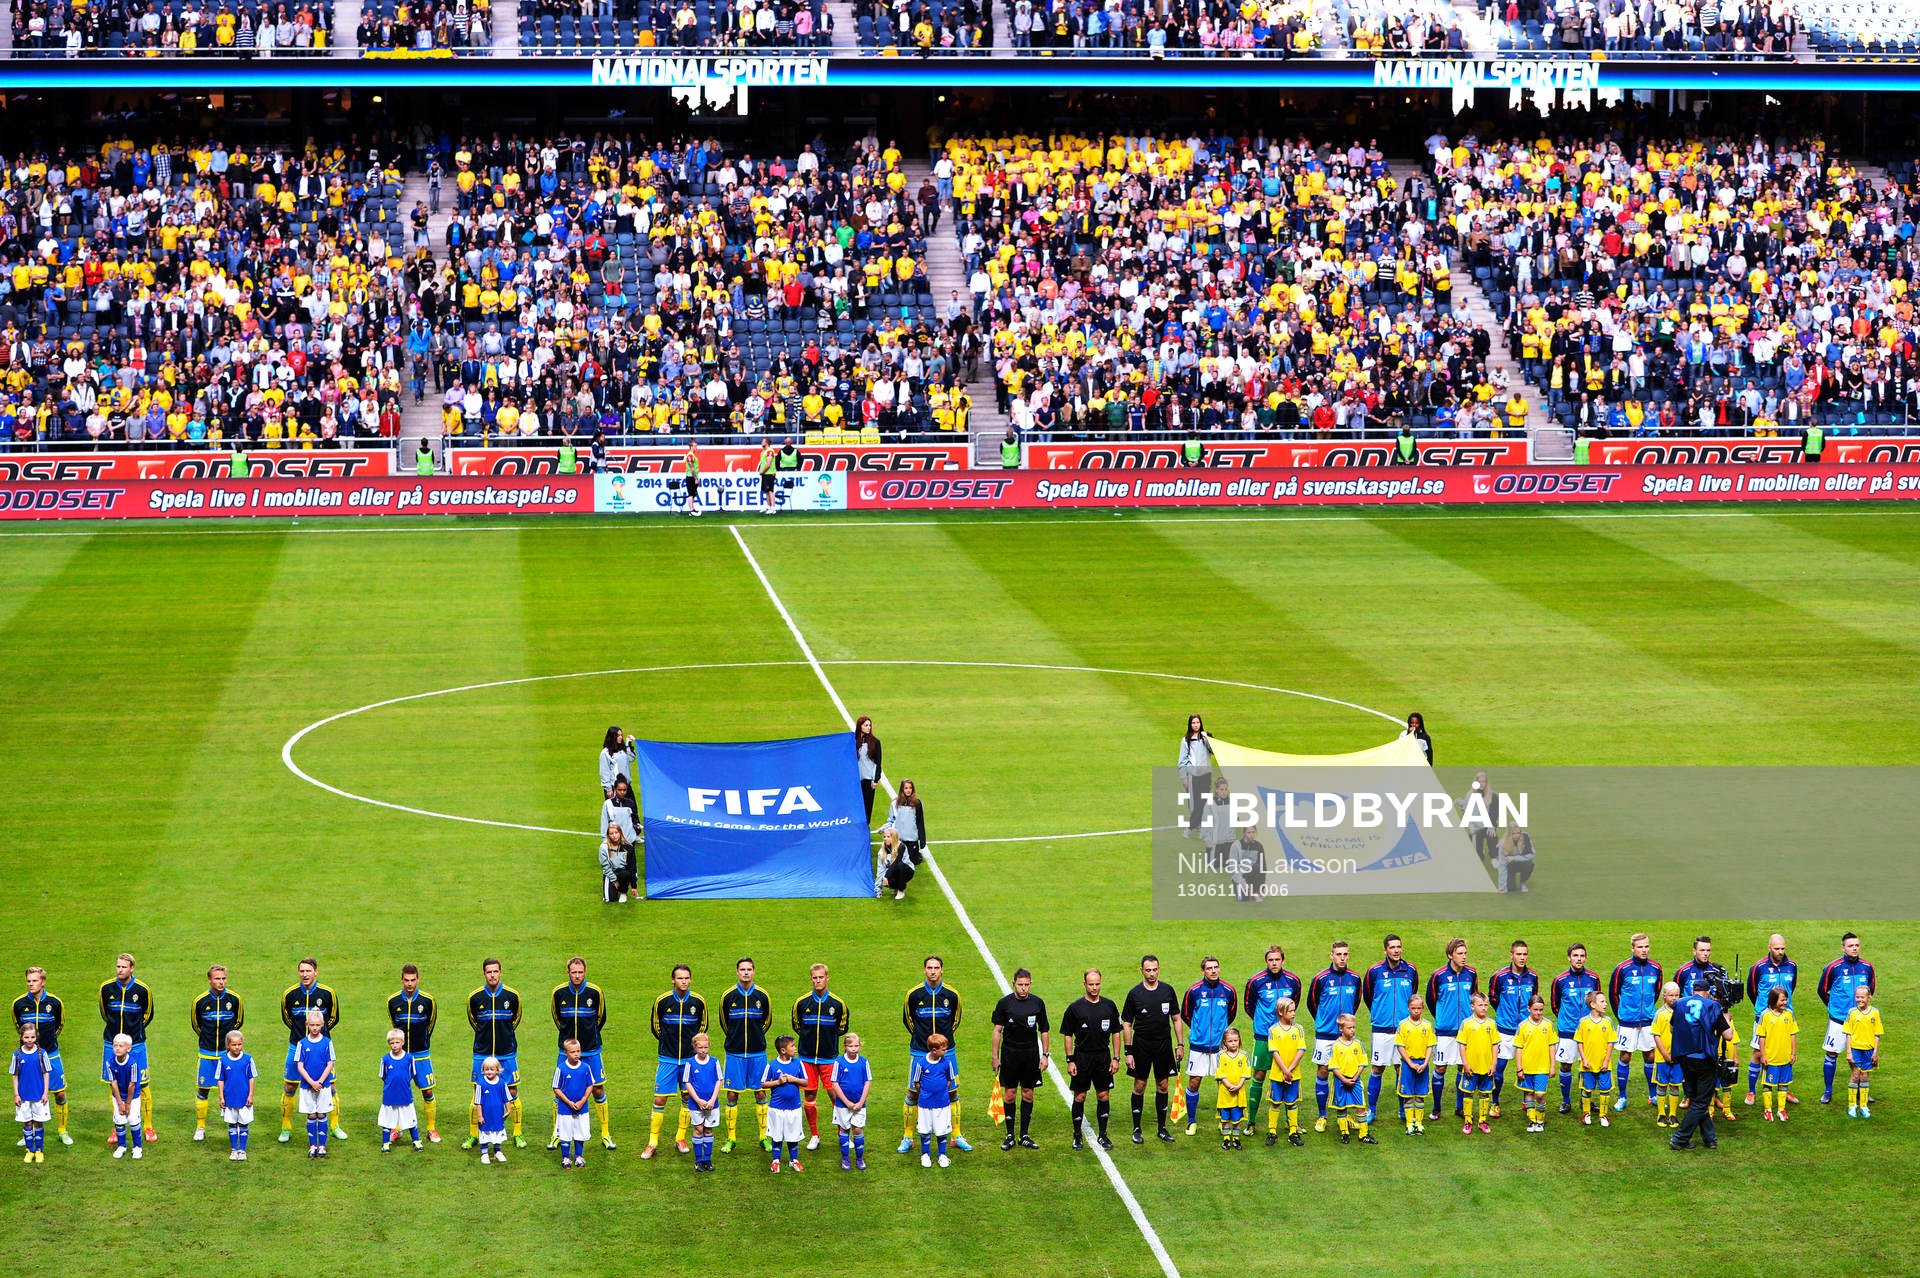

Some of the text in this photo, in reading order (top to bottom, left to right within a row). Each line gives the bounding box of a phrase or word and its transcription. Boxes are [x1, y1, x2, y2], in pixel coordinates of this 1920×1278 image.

[592, 59, 828, 84] NATIONALSPORTEN
[1374, 61, 1599, 86] NATIONALSPORTEN
[490, 455, 685, 475] ODSET
[757, 452, 949, 472] DDSET
[1078, 449, 1268, 469] ODDET
[1322, 448, 1509, 467] ODSET
[636, 478, 662, 489] 2014
[697, 478, 732, 488] ORLD
[736, 478, 760, 488] CUP
[773, 477, 804, 487] RAIL
[880, 479, 1014, 501] ODDSET
[1036, 476, 1445, 502] Spela live i mobilen eller på svenskaspel.se
[1493, 473, 1621, 494] ODDSET
[1642, 474, 1694, 496] Spela
[1697, 474, 1732, 492] live
[1735, 474, 1745, 491] i
[1747, 473, 1820, 491] mobilen
[1824, 473, 1867, 490] eller
[1868, 471, 1893, 494] på
[149, 485, 577, 512] Spela live i mobilen eller på svenskaspel.se
[687, 786, 823, 816] FIFA
[665, 815, 852, 831] For the Game. For the World.
[1381, 852, 1429, 869] FIFA
[1684, 1000, 1702, 1023] 3
[1373, 1052, 1379, 1061] 5
